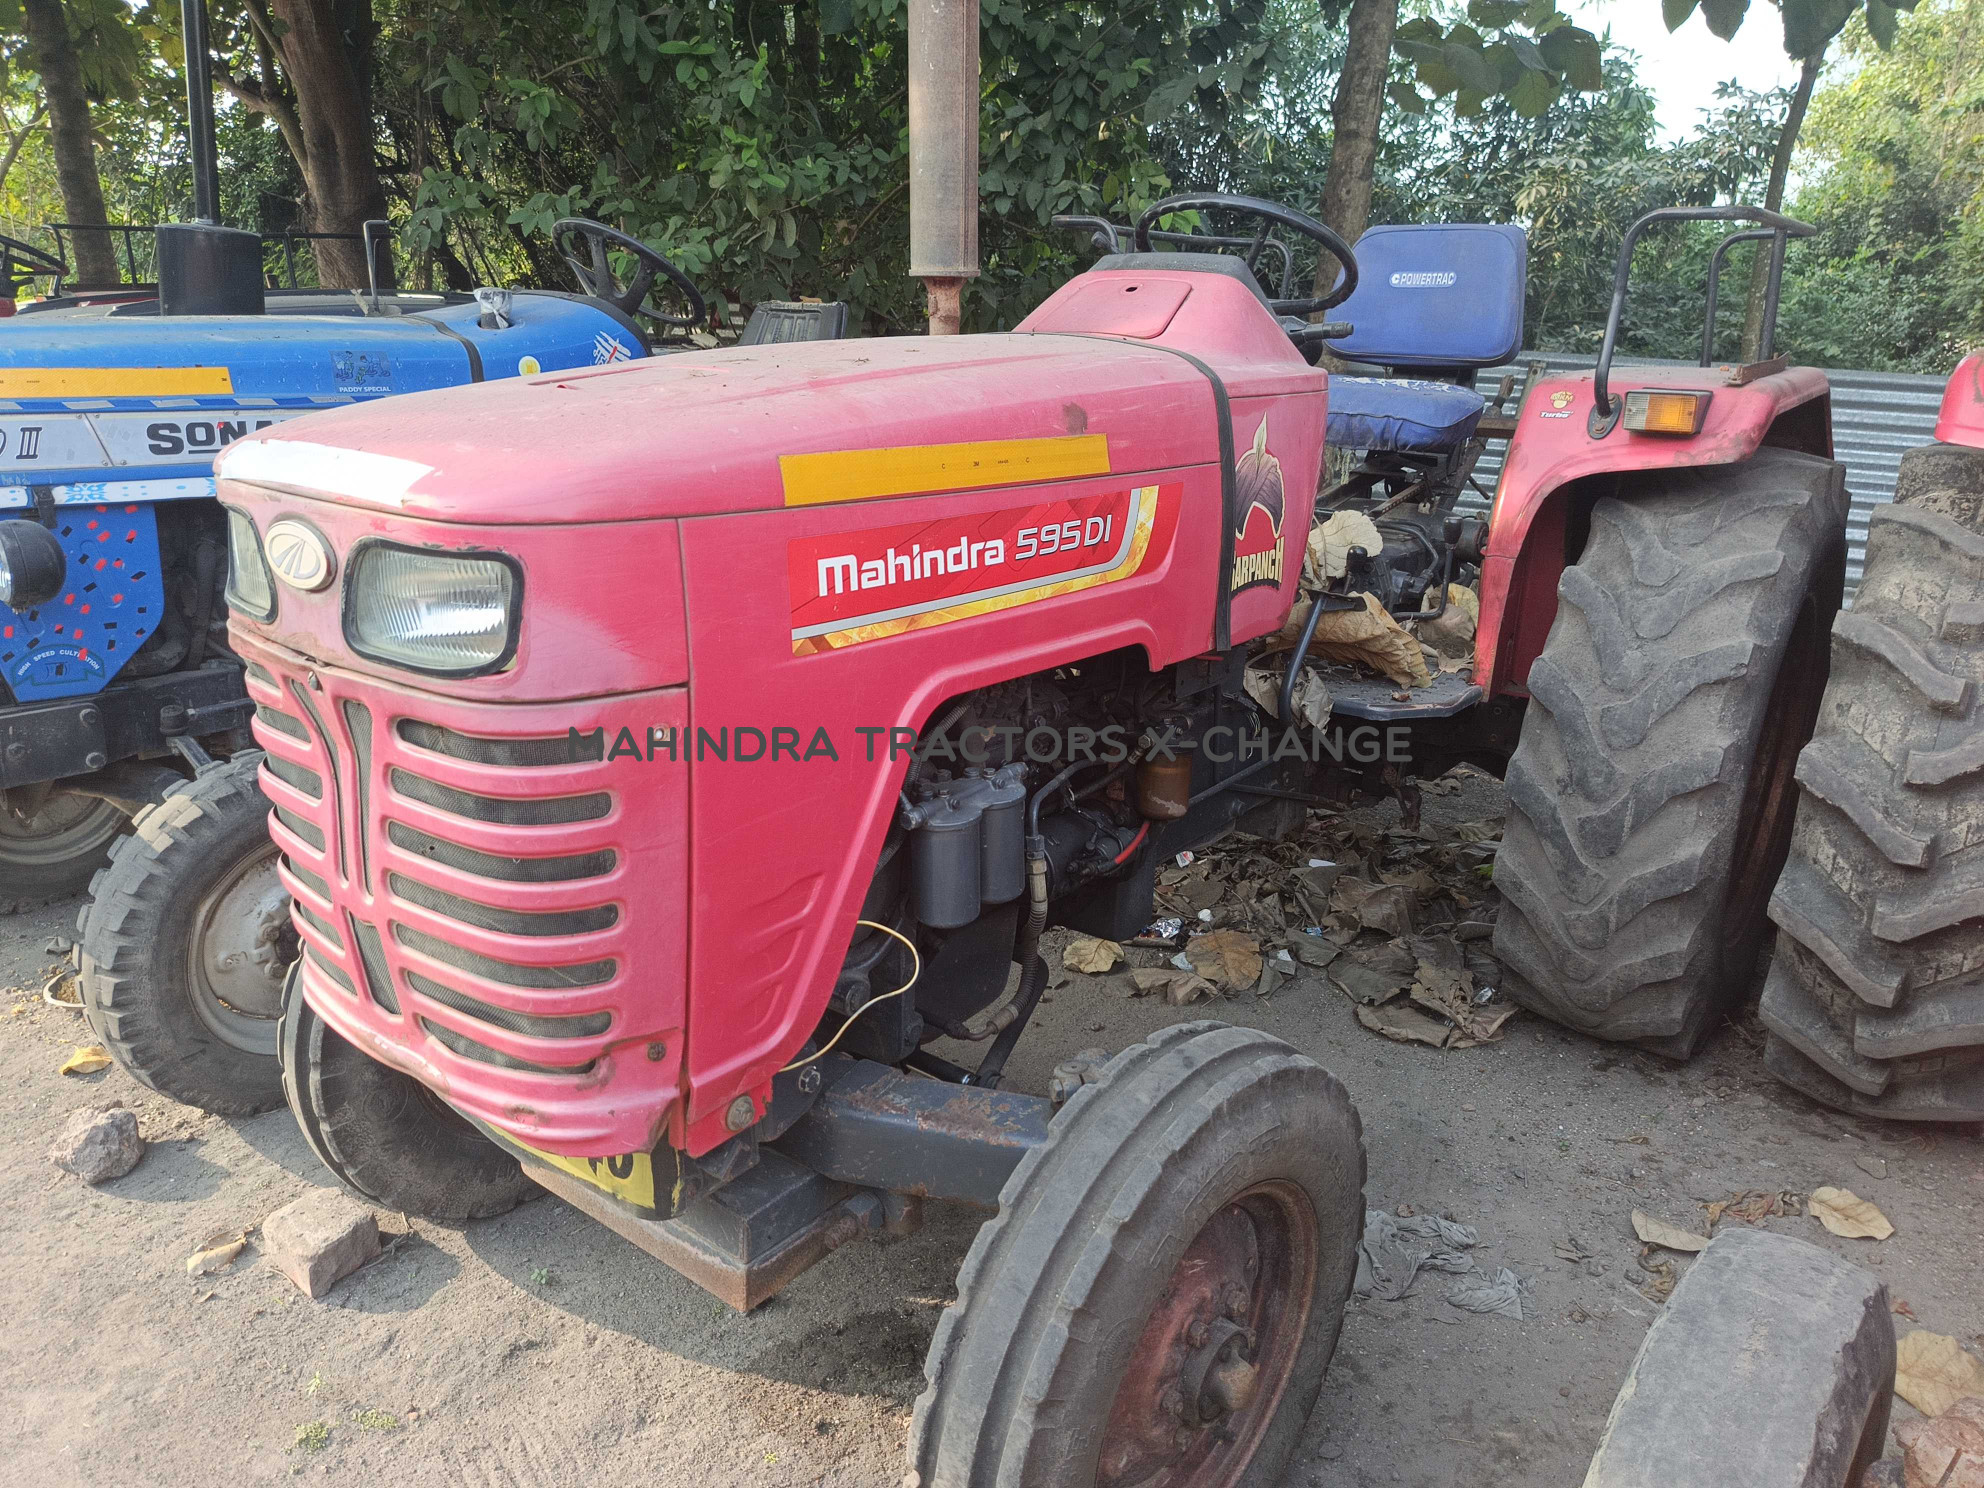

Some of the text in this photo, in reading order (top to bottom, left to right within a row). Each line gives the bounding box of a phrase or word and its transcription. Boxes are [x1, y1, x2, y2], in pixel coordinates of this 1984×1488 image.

[1400, 272, 1455, 285] POWERTRAC
[817, 536, 1005, 597] Mahindra
[17, 649, 100, 676] HIGH SPEED CULTITION
